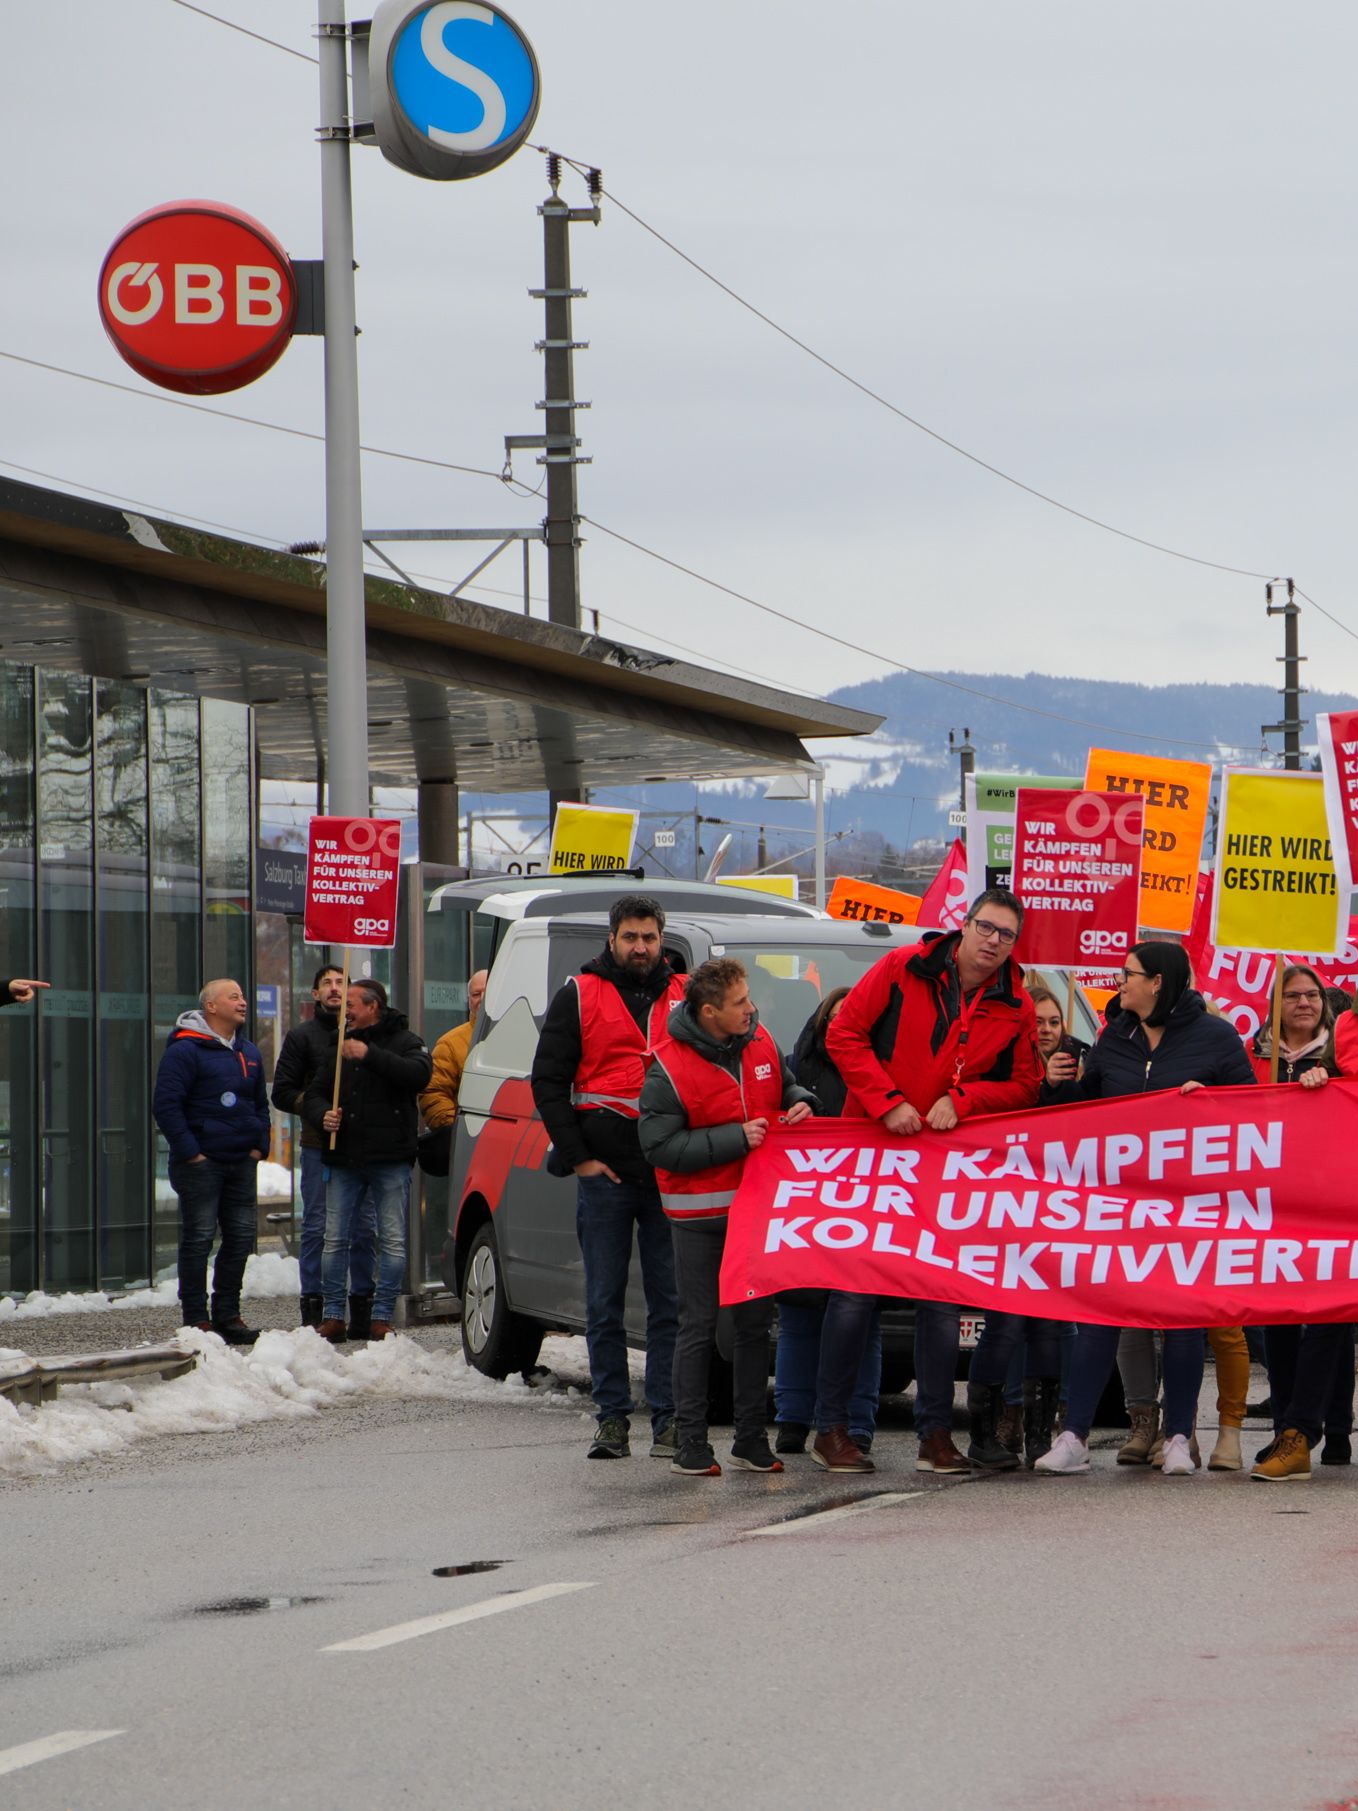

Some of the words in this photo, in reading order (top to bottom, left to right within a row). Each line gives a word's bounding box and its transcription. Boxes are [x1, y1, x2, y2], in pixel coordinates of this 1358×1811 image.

[420, 1, 506, 150] S
[108, 262, 283, 326] ÖBB
[1025, 821, 1056, 835] WIR
[315, 839, 337, 850] WIR
[656, 835, 674, 844] 100
[1024, 838, 1102, 856] KÄMPFEN
[1227, 834, 1272, 857] HIER
[1281, 837, 1333, 861] WIRD
[314, 852, 370, 865] KÄMPFEN
[554, 850, 585, 869] HIER
[591, 854, 625, 869] WIRD
[1023, 856, 1055, 873] FÜR
[1058, 861, 1132, 876] UNSEREN
[264, 861, 293, 890] Salzburg
[313, 865, 336, 877] FÜR
[339, 868, 393, 880] UNSEREN
[1224, 867, 1336, 895] GESTREIKT!
[313, 880, 379, 892] KOLLEKTIV-
[1022, 877, 1115, 894] KOLLEKTIV-
[312, 893, 364, 905] VERTRAG
[1021, 896, 1094, 912] VERTRAG
[353, 918, 389, 936] gpa
[1080, 930, 1127, 954] gpa
[784, 1148, 920, 1183] WIR
[942, 1120, 1284, 1187] KÄMPFEN
[773, 1176, 914, 1216] FÜR
[937, 1187, 1274, 1231] UNSEREN
